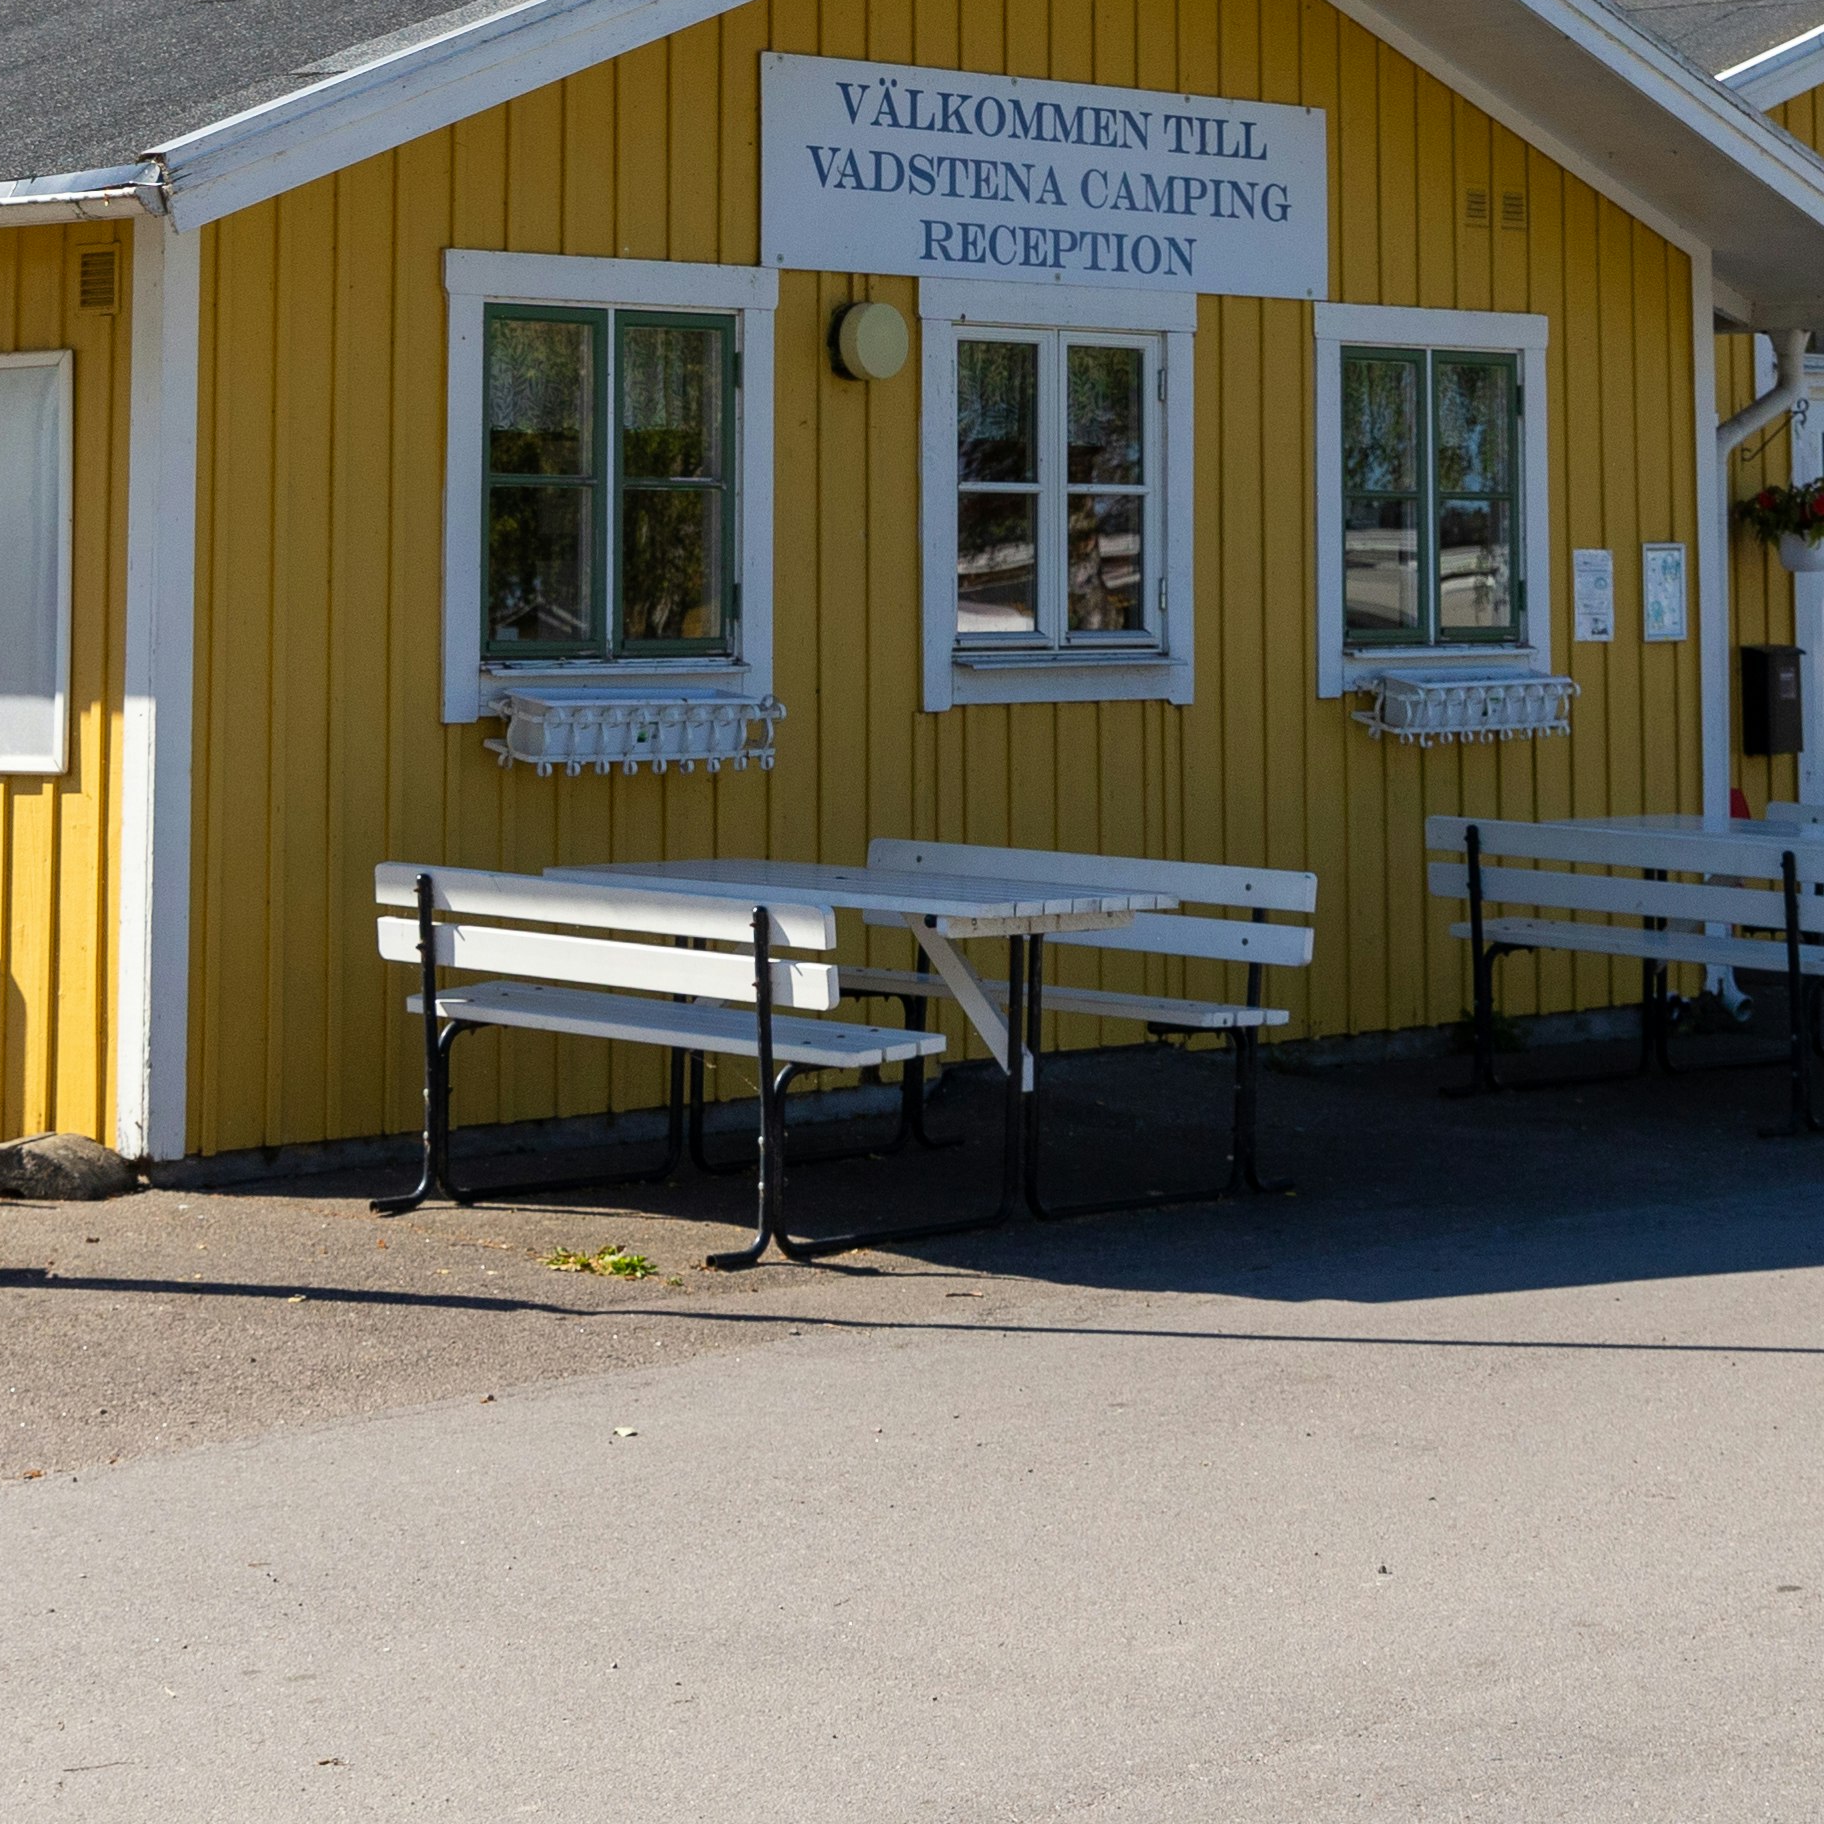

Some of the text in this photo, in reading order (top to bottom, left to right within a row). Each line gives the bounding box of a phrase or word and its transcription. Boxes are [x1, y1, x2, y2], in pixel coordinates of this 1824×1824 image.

[836, 77, 1268, 161] VÄLKOMMEN TILL
[806, 144, 1292, 222] VADSTENA CAMPING
[919, 219, 1197, 276] RECEPTION
